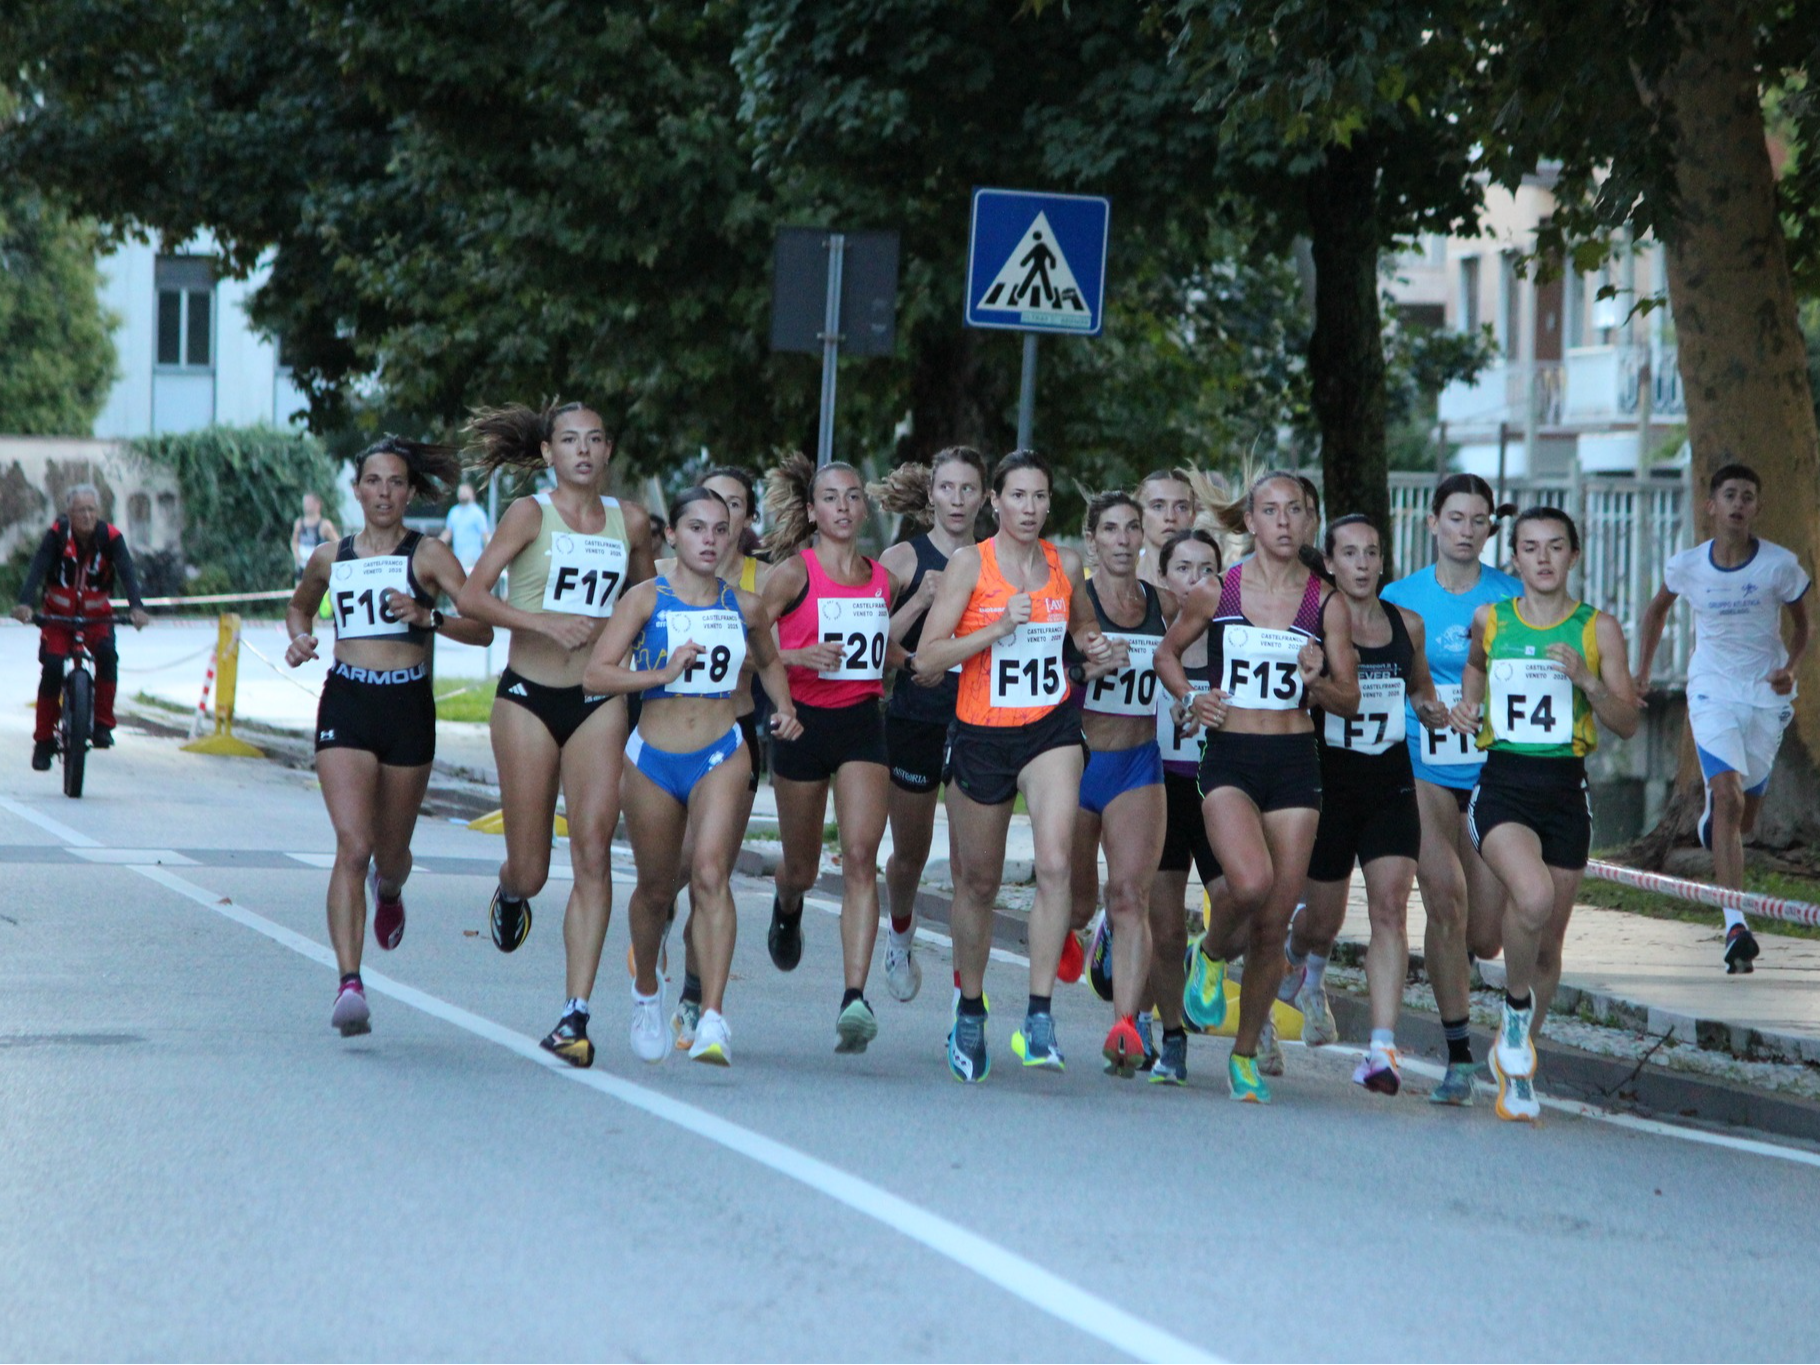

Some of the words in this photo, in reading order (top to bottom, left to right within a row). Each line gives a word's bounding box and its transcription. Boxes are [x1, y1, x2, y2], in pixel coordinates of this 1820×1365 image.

[584, 539, 621, 550] CASTELFRANCO
[363, 560, 403, 568] CASTELFRANCO
[553, 566, 620, 607] F17
[1027, 626, 1062, 635] CASTELFRANCO
[684, 645, 730, 683] F8
[999, 656, 1060, 697] F15
[1228, 659, 1298, 700] F13
[1092, 669, 1157, 706] F10
[1344, 713, 1388, 748] F7
[1507, 694, 1556, 732] F4
[893, 766, 927, 784] ASTORIA
